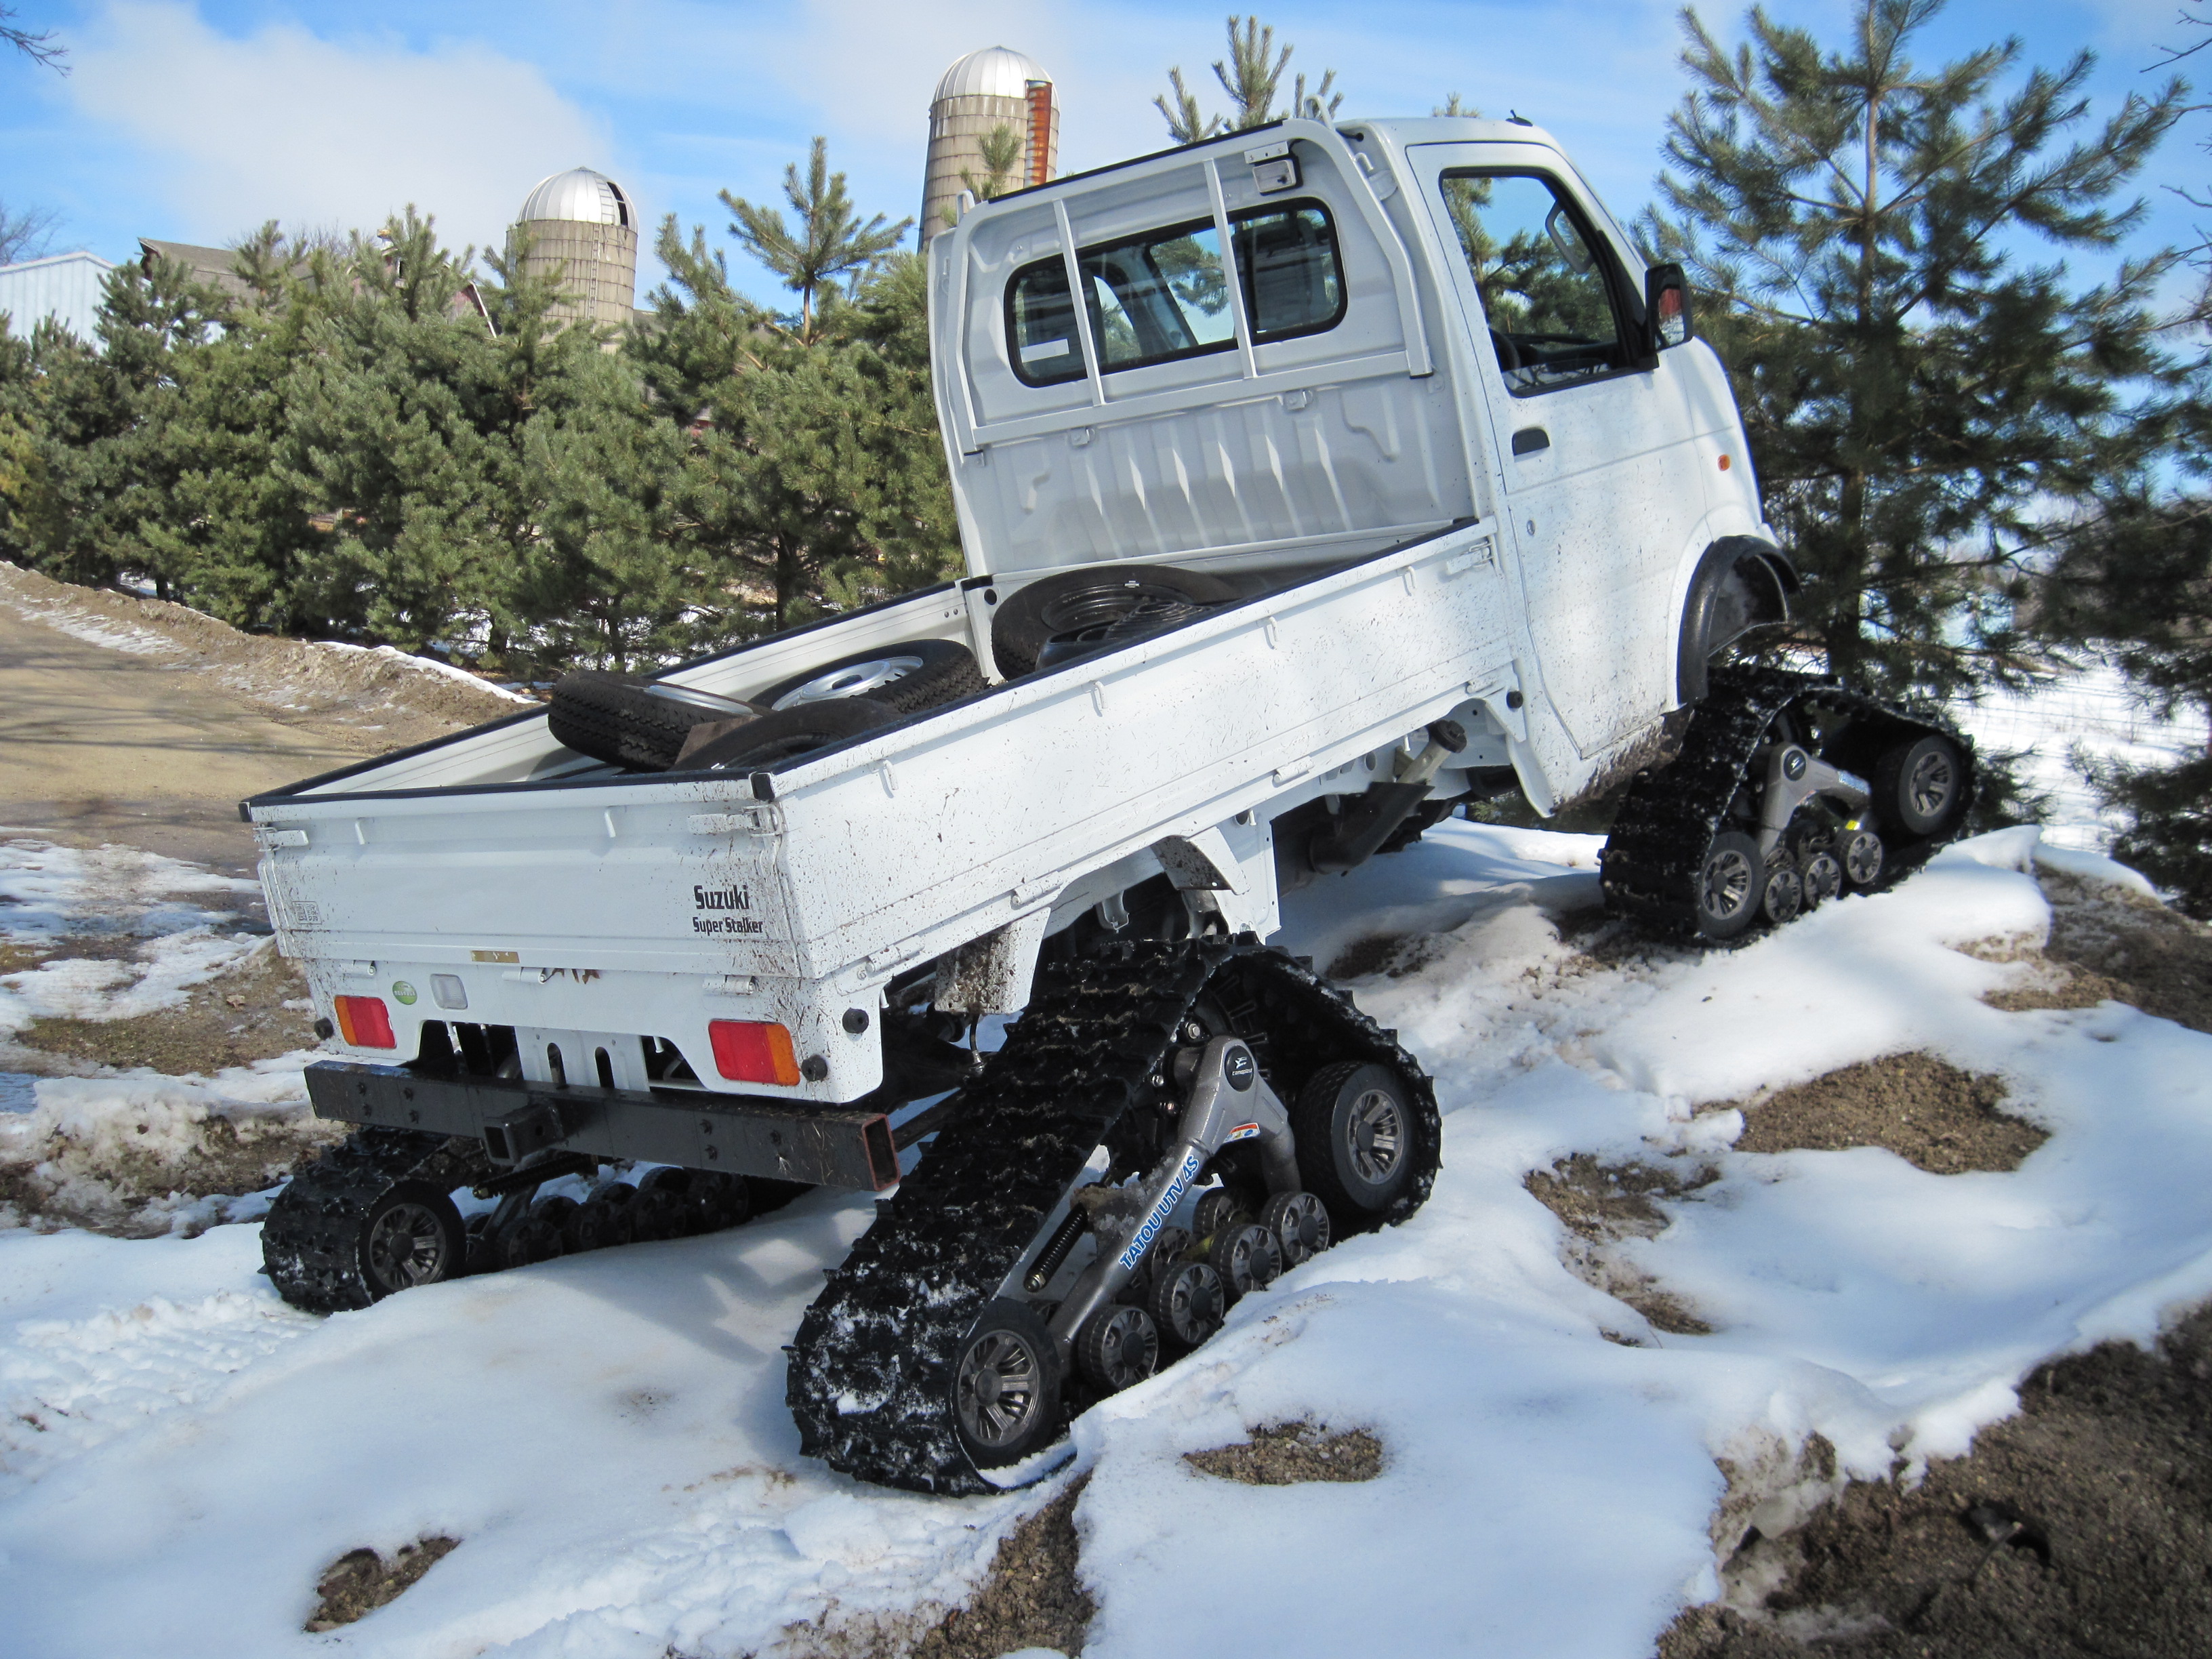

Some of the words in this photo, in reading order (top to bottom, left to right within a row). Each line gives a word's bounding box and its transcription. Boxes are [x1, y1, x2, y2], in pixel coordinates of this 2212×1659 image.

[693, 884, 750, 909] Suzuki
[693, 917, 722, 936] Super
[724, 917, 763, 933] Stalker
[1119, 1212, 1162, 1269] TATOU
[1158, 1176, 1185, 1215] UTV
[1181, 1155, 1199, 1182] 4S
